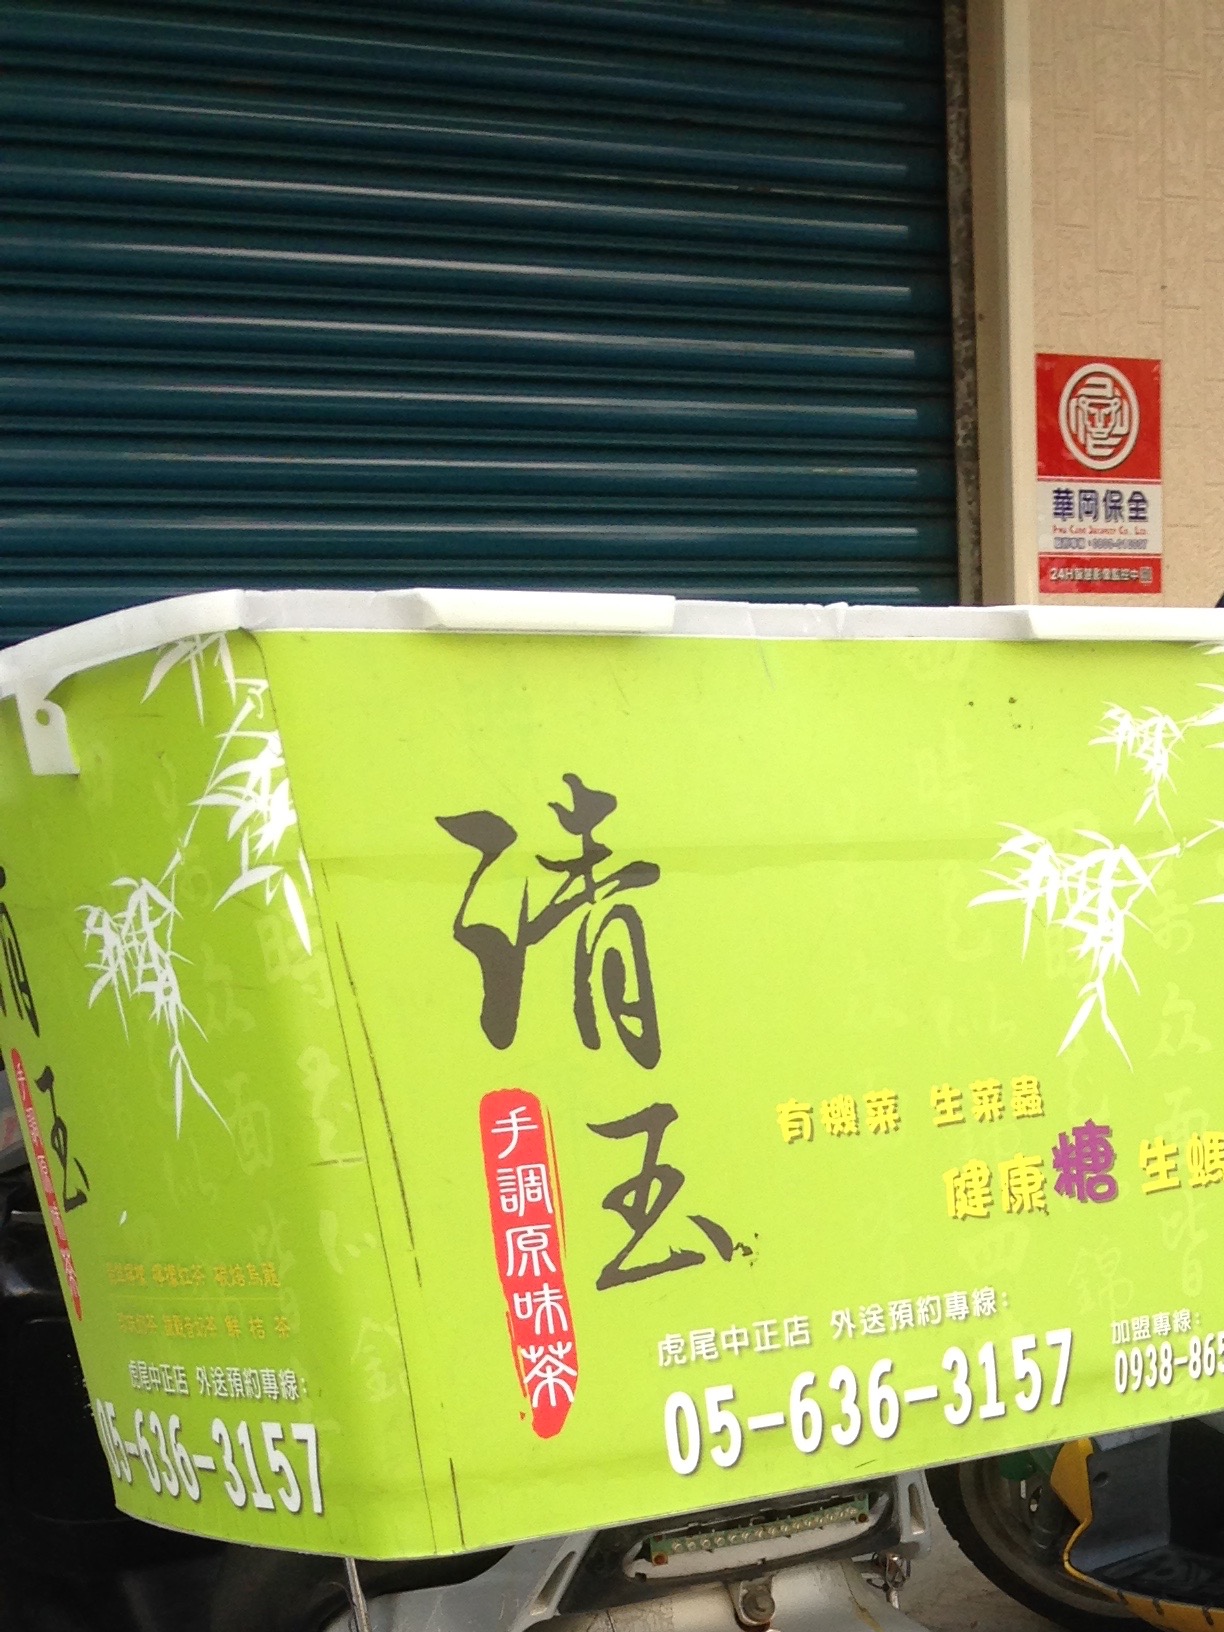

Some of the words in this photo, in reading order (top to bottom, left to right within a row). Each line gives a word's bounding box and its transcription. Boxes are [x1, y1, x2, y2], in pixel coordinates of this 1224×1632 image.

[1053, 487, 1148, 522] 華岡保全
[776, 1088, 902, 1144] 有機菜
[930, 1075, 1046, 1128] 生菜蟲
[943, 1118, 1119, 1219] 健康糖
[491, 1106, 577, 1408] 手調原味茶
[128, 1359, 190, 1396] 虎尾中正店
[657, 1314, 812, 1368] 虎尾中正店
[663, 1328, 1075, 1477] 05-636-3157
[96, 1398, 325, 1515] 05-636-3157
